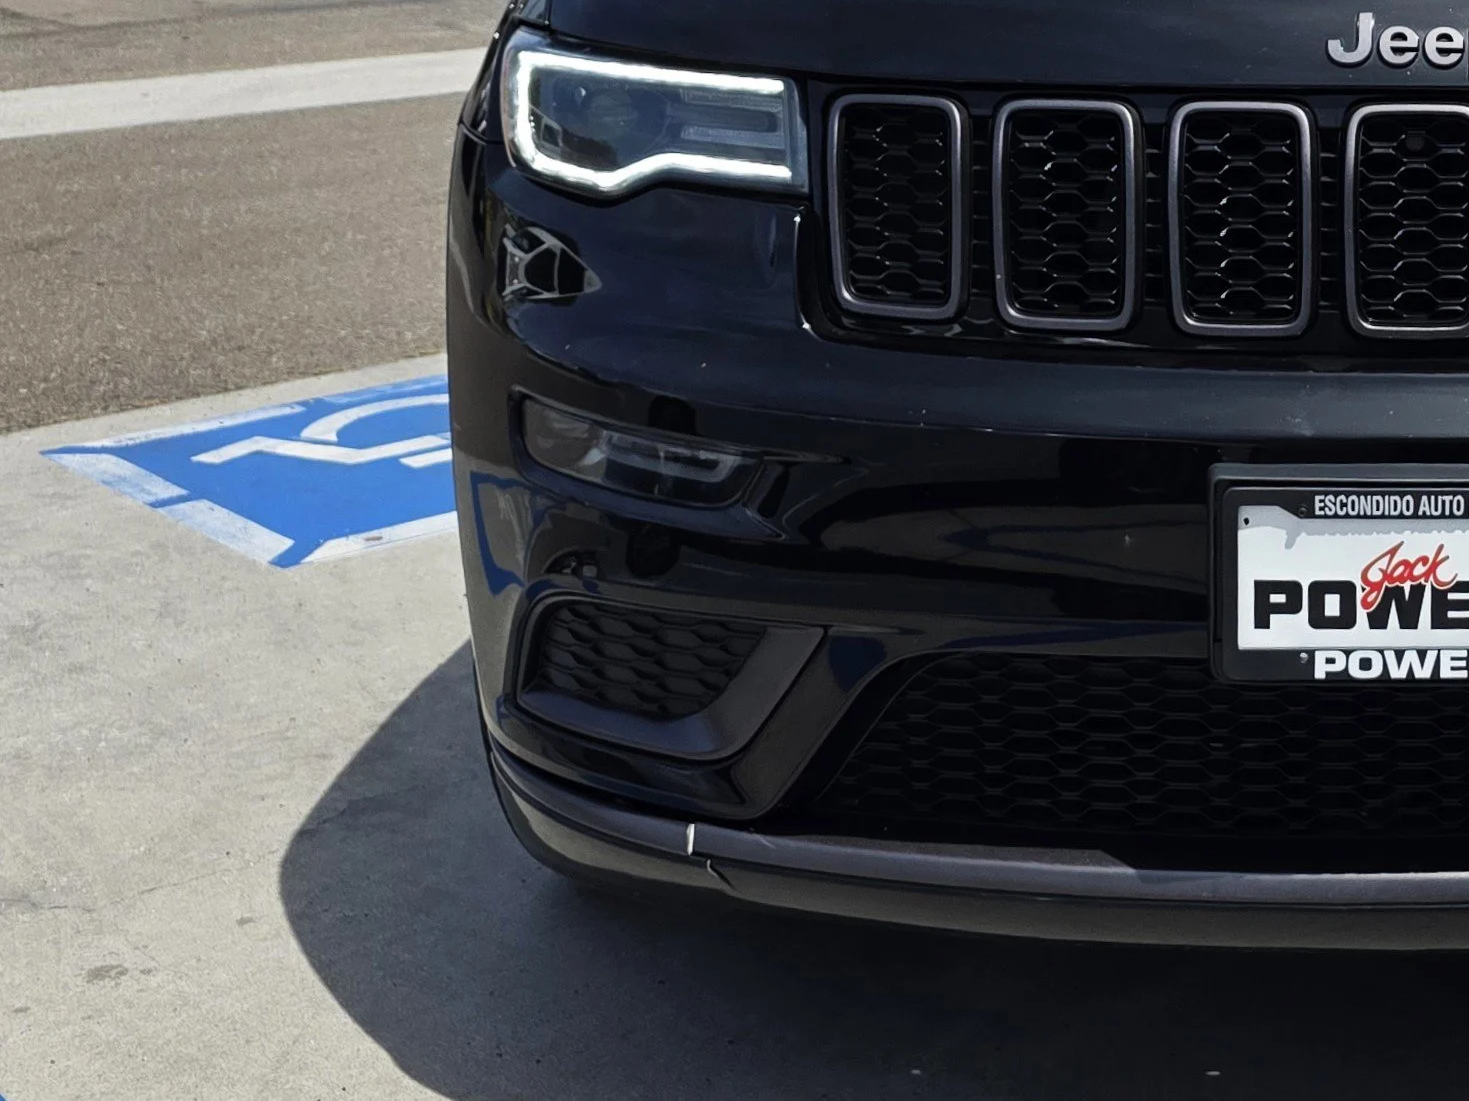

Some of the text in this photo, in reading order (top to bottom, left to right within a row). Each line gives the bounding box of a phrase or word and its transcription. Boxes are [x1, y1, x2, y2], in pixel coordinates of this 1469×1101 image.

[1314, 495, 1414, 517] ESCONDIDO
[1418, 495, 1465, 517] AUTO
[1360, 540, 1458, 613] Jack
